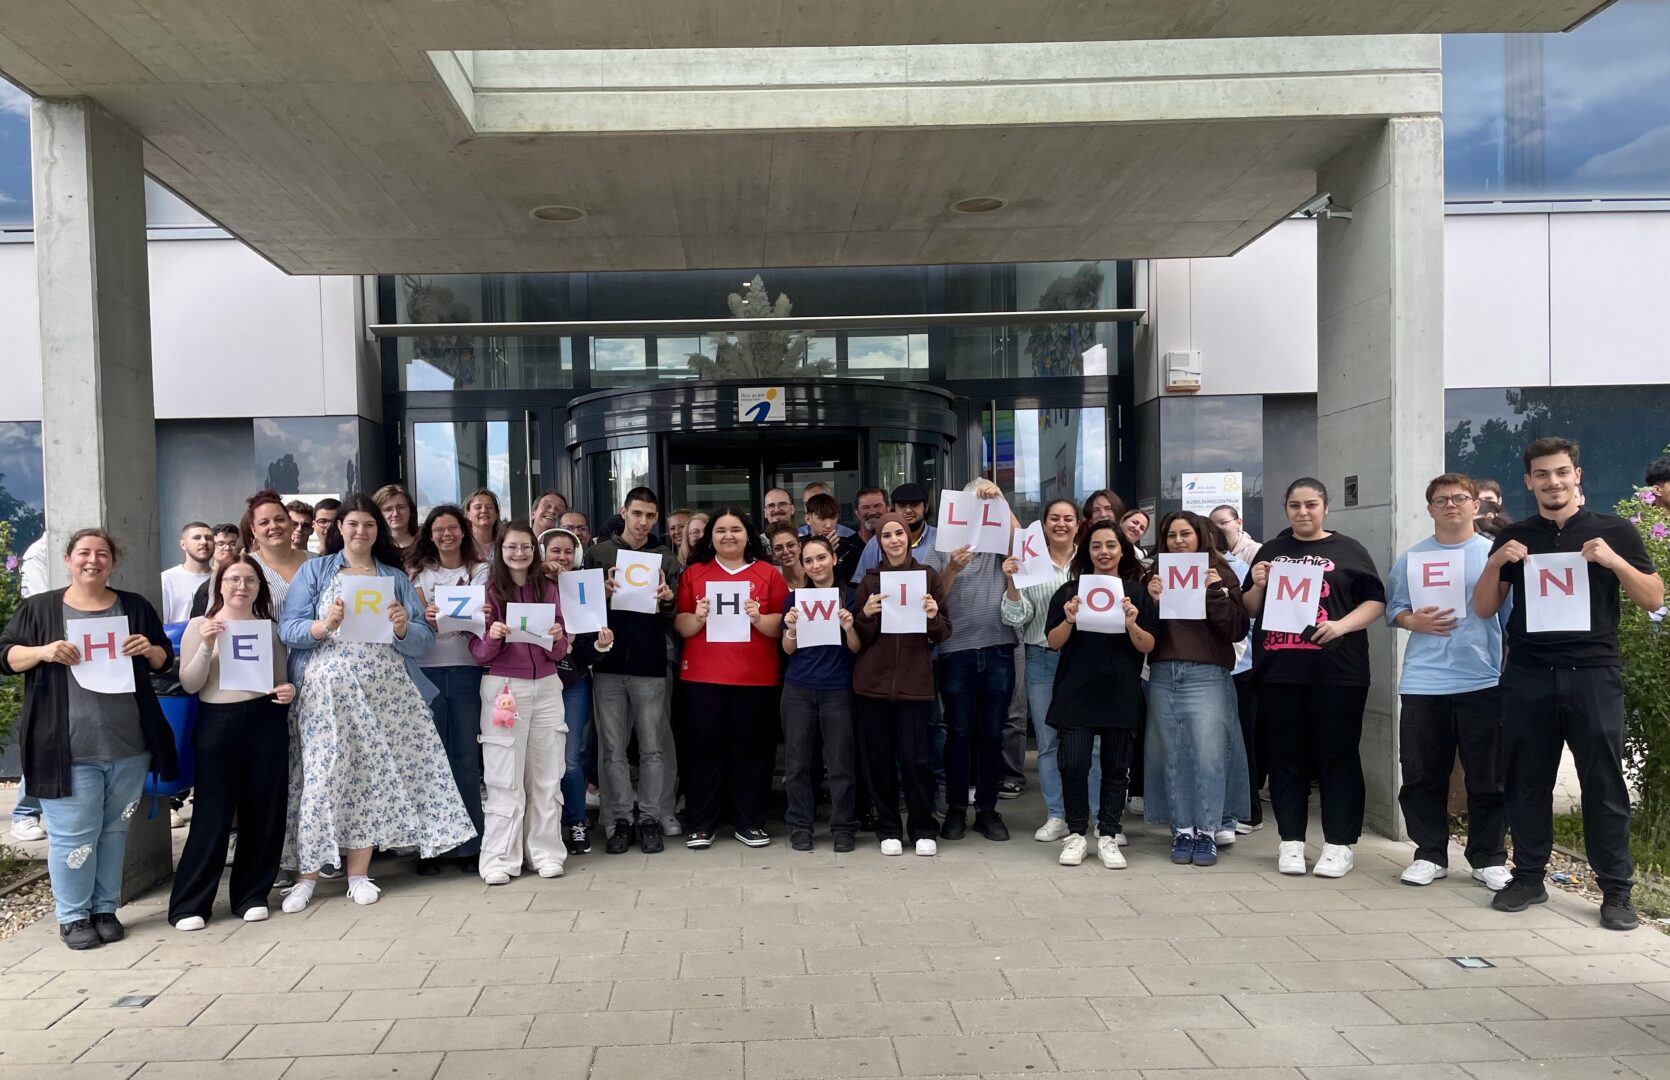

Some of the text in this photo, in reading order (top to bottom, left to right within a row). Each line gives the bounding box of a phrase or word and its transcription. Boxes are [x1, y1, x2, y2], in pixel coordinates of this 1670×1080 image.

[947, 502, 1002, 528] L L
[1020, 534, 1039, 563] K
[624, 563, 650, 588] C
[1168, 565, 1200, 590] M
[1422, 561, 1451, 588] E
[1538, 567, 1575, 597] N
[577, 582, 587, 605] I
[899, 583, 908, 606] I
[1086, 587, 1116, 612] O
[1276, 575, 1313, 603] M
[353, 590, 383, 615] R
[447, 596, 473, 621] Z
[716, 592, 740, 615] H
[799, 599, 837, 622] W
[82, 631, 117, 662] H
[231, 633, 260, 662] E
